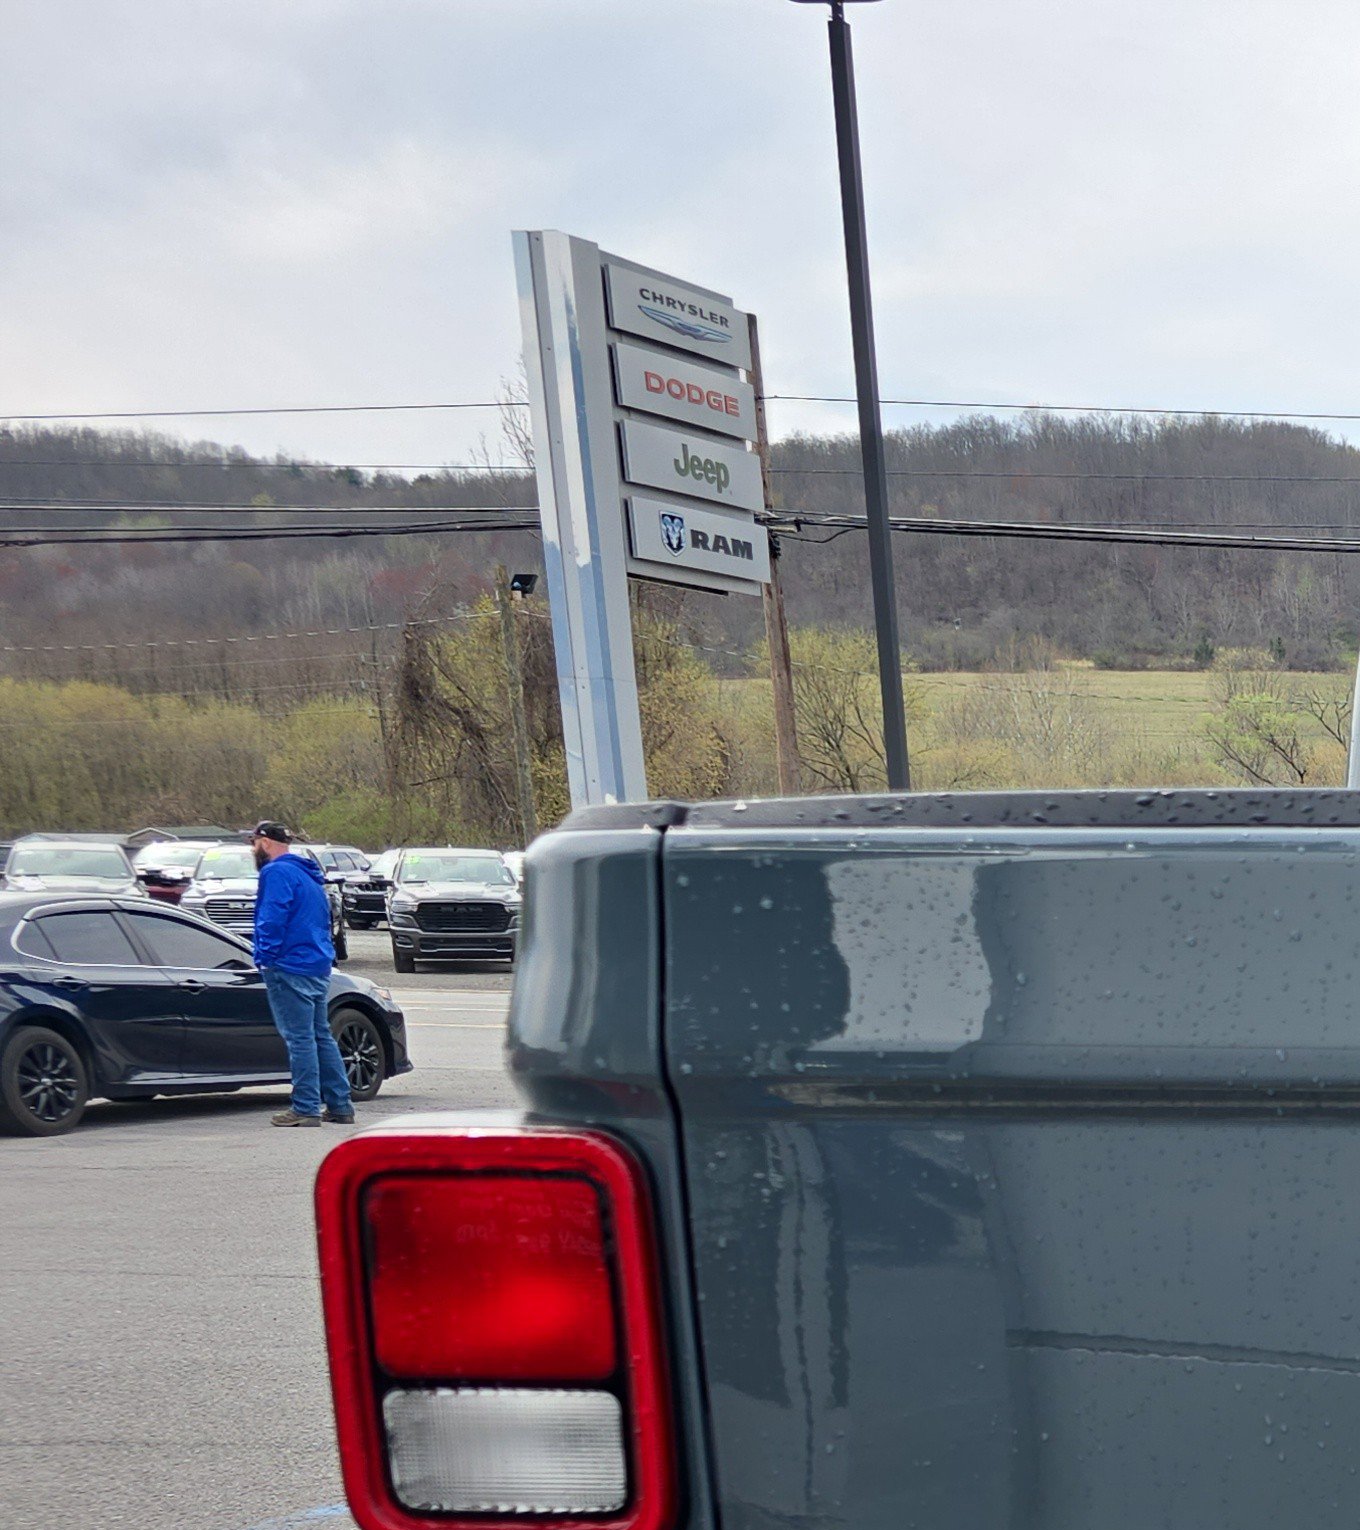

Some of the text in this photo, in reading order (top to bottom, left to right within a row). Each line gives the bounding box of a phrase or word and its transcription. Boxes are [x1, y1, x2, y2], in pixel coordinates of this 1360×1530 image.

[638, 287, 730, 329] CHRYSLER
[643, 370, 740, 418] DODGE
[673, 443, 730, 494] Jeep
[690, 529, 754, 561] RAM
